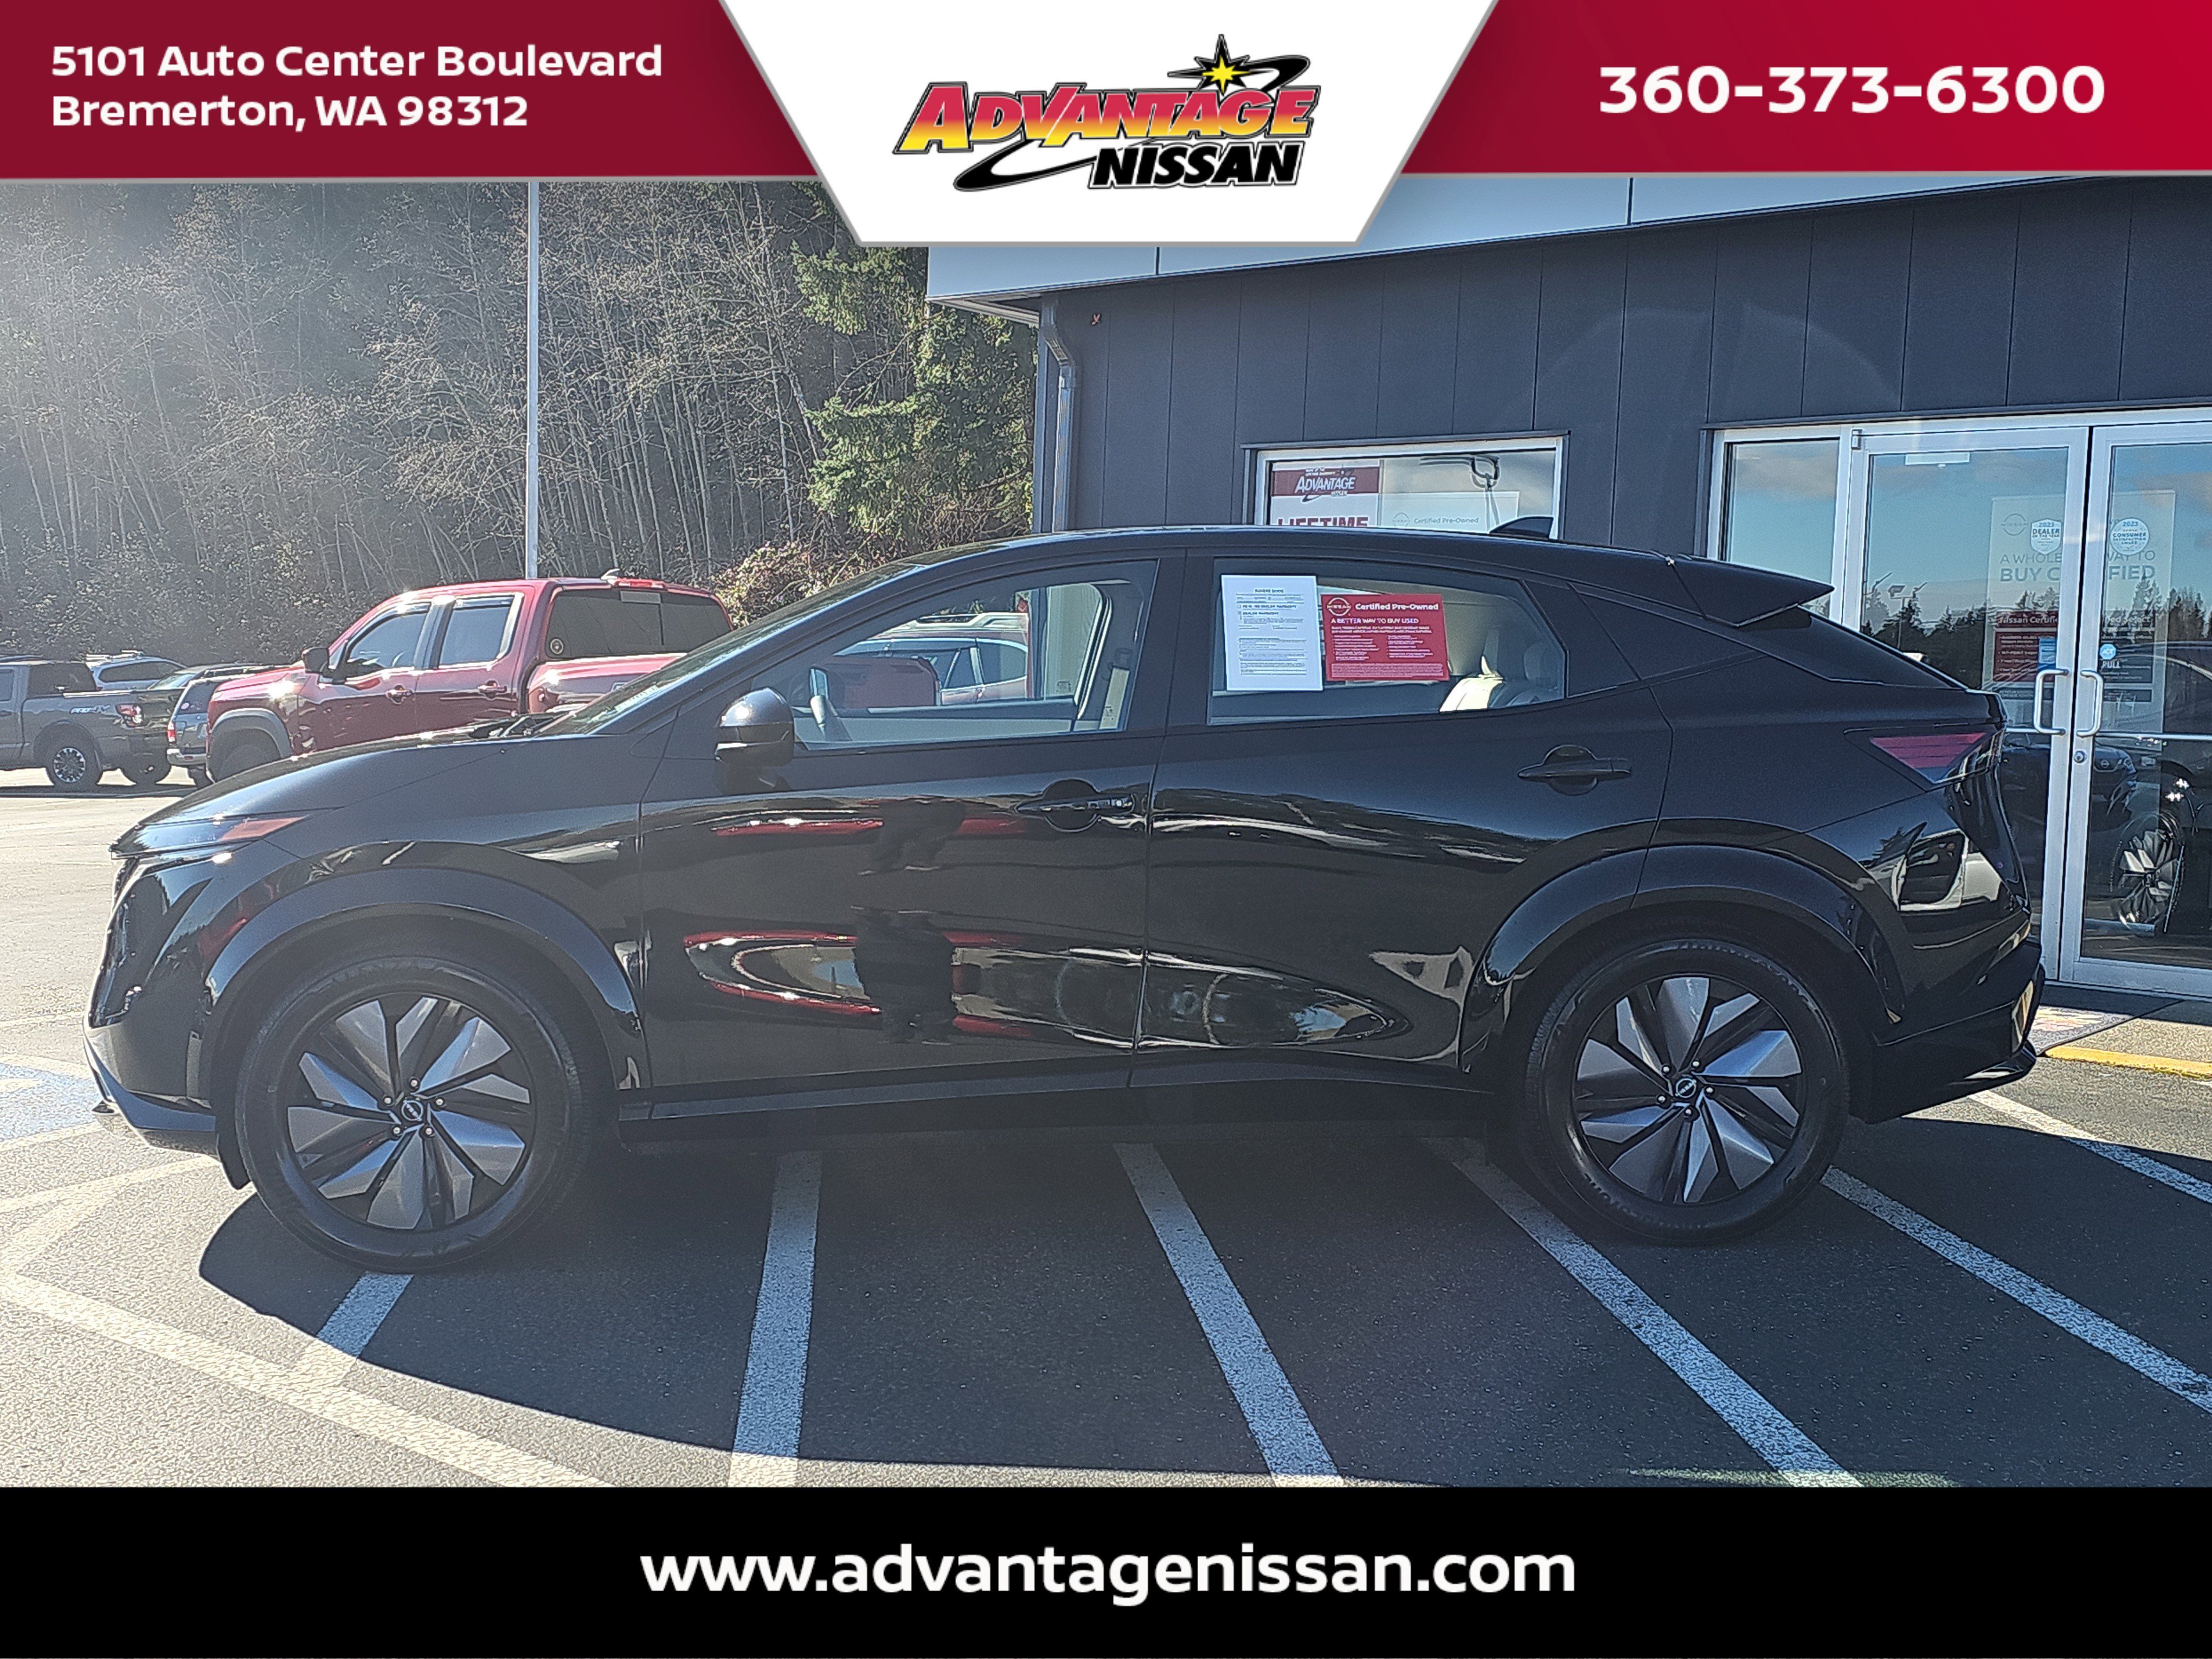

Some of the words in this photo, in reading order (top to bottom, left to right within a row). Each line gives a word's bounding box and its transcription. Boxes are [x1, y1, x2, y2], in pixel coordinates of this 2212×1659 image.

[1294, 476, 1356, 494] ADVANTAGE
[1999, 554, 2010, 564] A
[2013, 552, 2062, 563] WHOLE
[2137, 550, 2156, 561] TO
[2000, 567, 2042, 582] BUY
